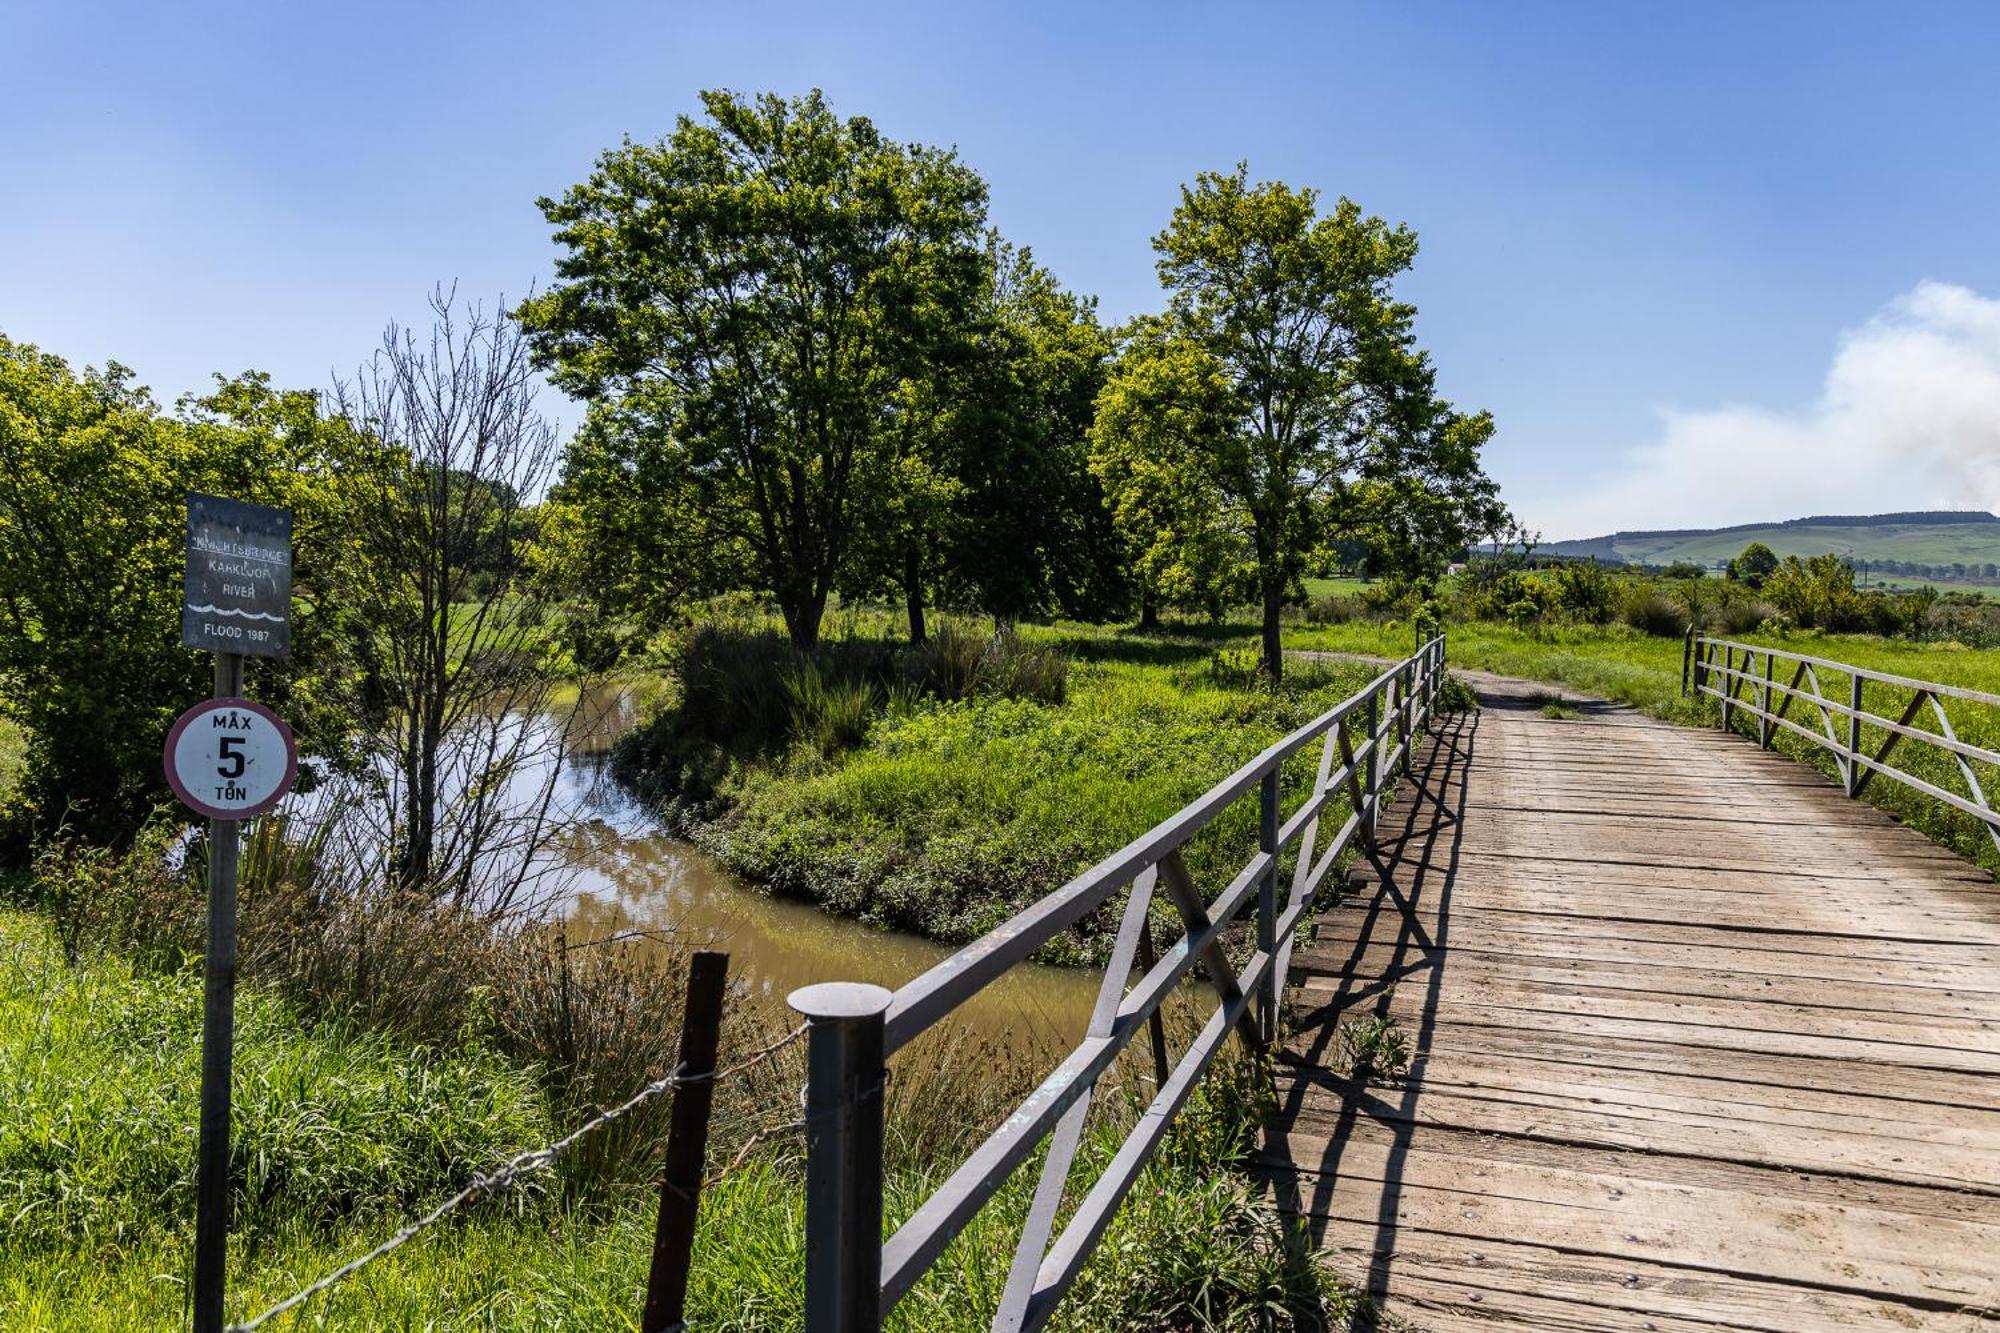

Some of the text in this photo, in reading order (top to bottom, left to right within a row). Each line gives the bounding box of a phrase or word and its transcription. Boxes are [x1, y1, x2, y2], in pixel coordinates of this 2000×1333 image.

[223, 583, 255, 599] RIVER
[204, 623, 269, 642] FLOOD 1987
[213, 715, 252, 730] MAX
[217, 737, 246, 779] 5
[215, 787, 246, 801] TON
